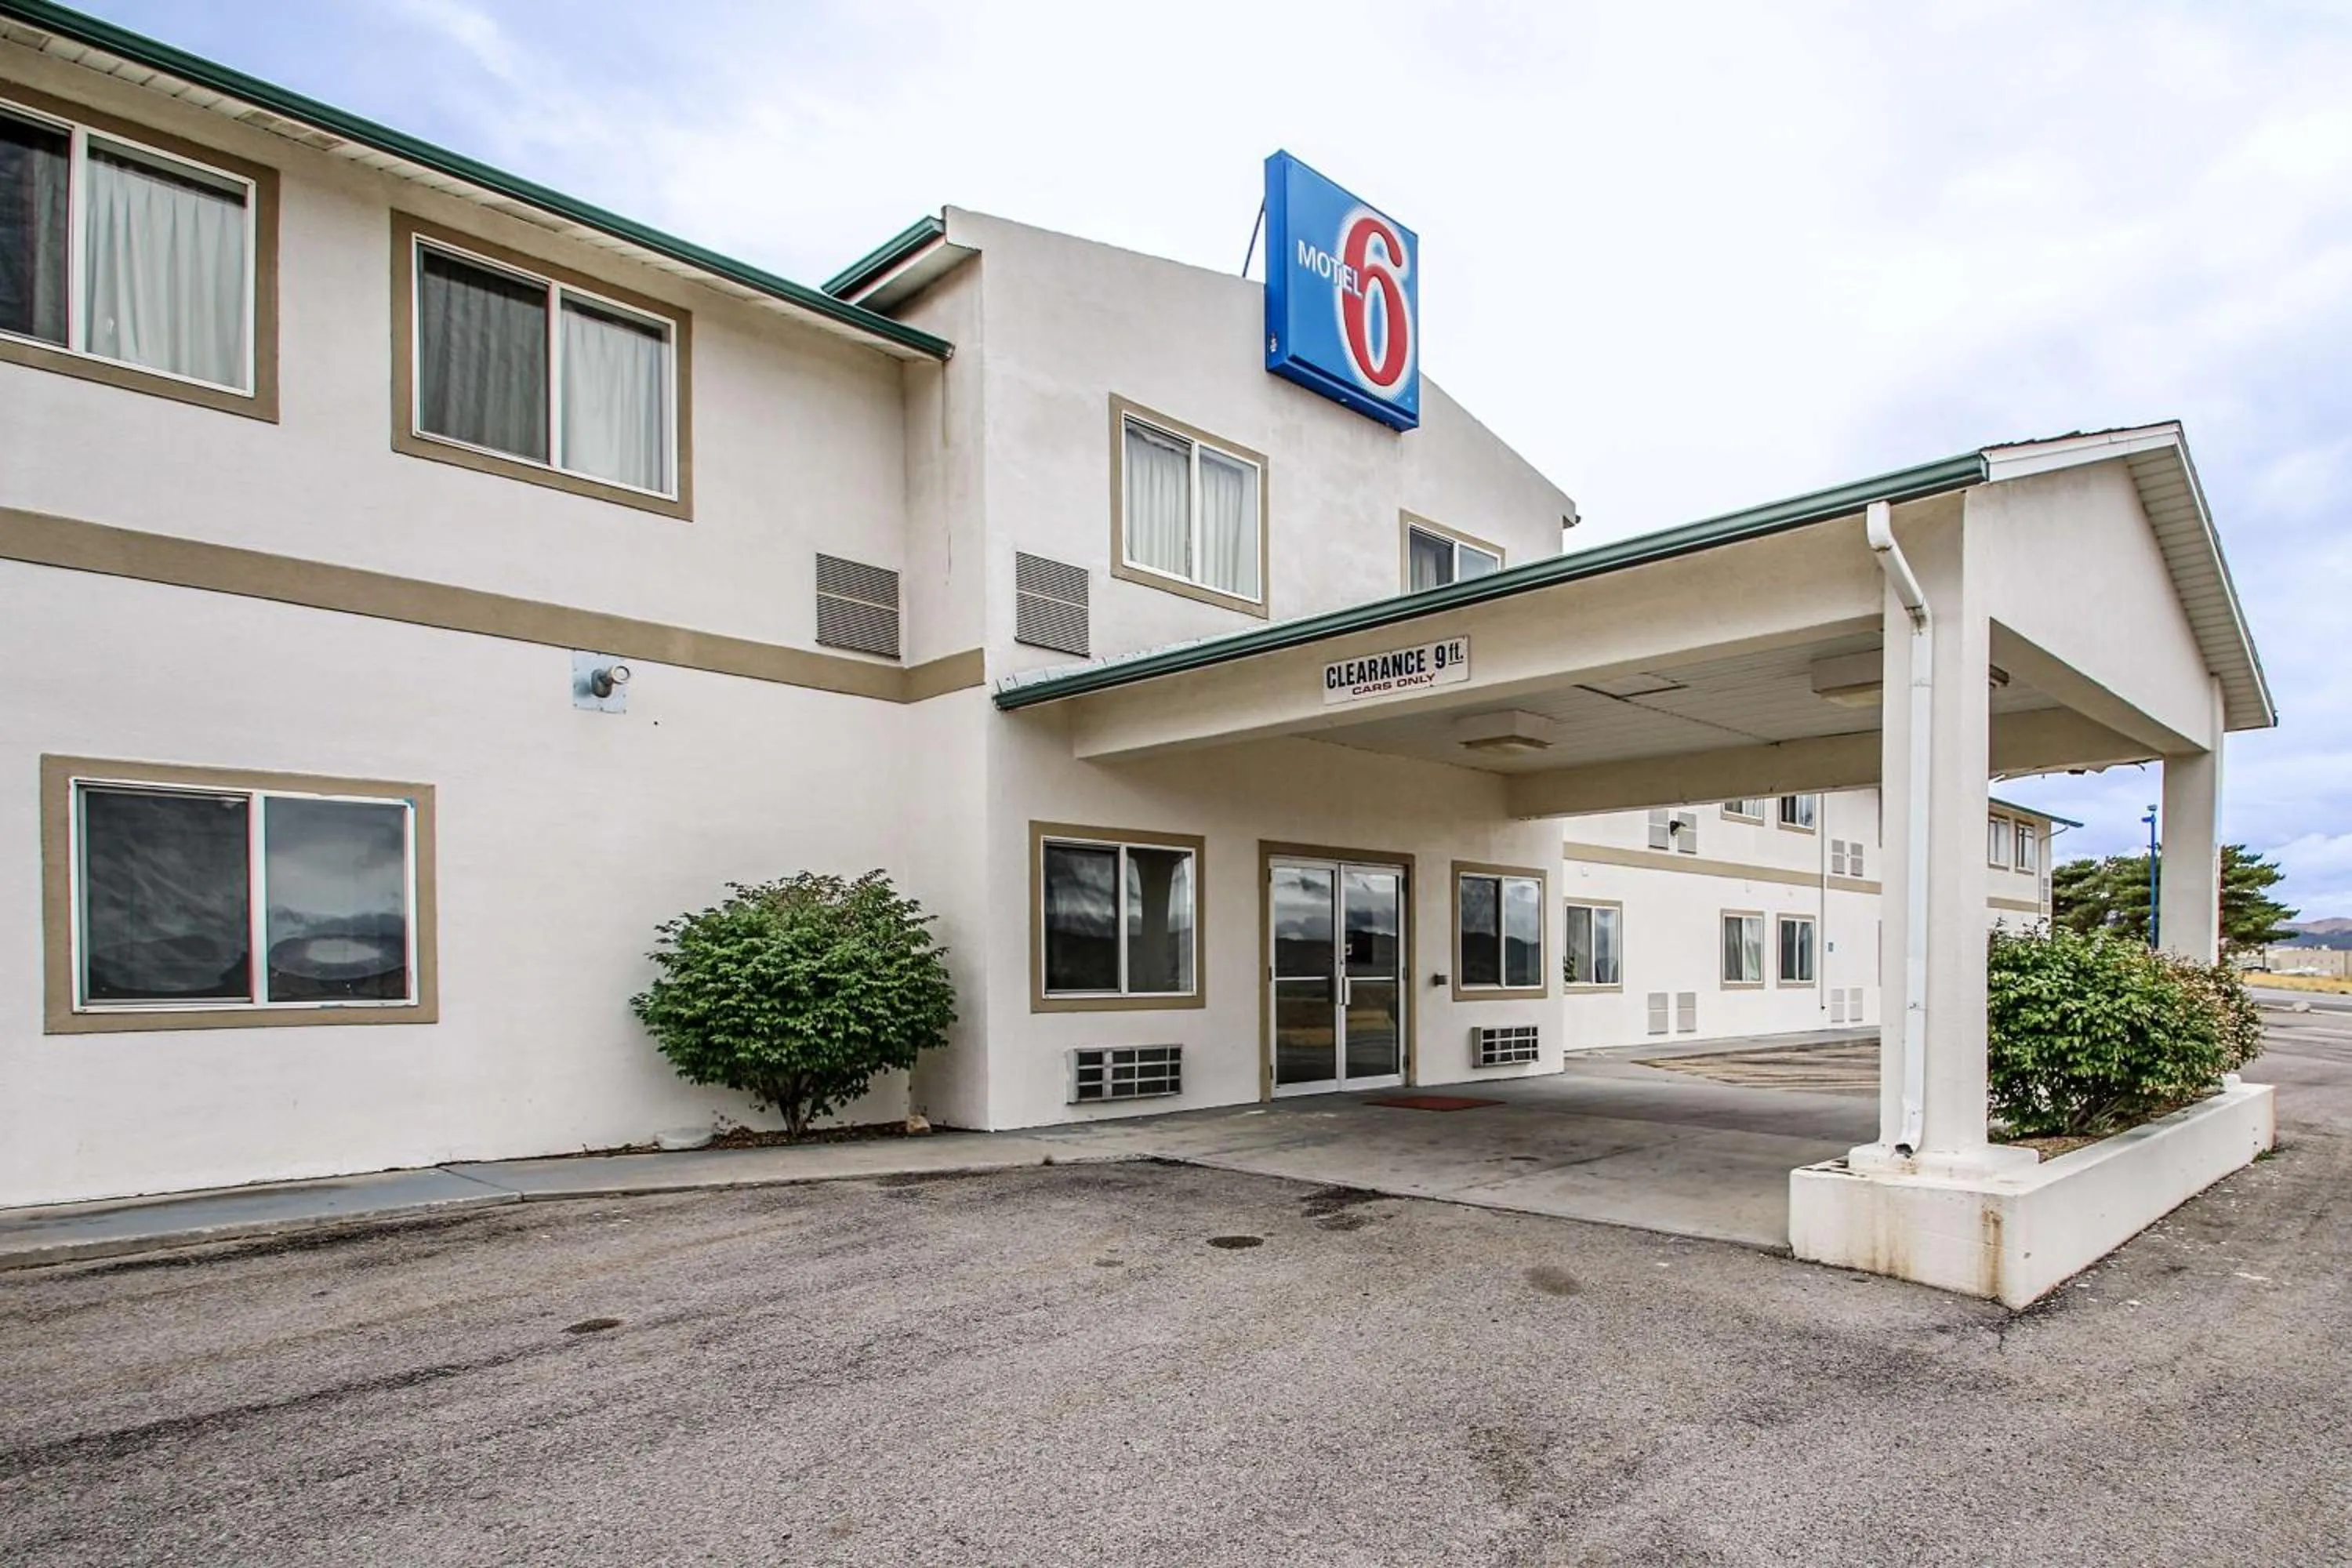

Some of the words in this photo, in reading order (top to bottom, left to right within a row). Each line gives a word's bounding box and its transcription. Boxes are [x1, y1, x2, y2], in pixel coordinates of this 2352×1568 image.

[1298, 240, 1363, 298] MOTEL
[1342, 216, 1410, 387] 6
[1326, 649, 1426, 689] CLEARANCE
[1352, 681, 1392, 695] CARS
[1396, 673, 1436, 688] ONLY
